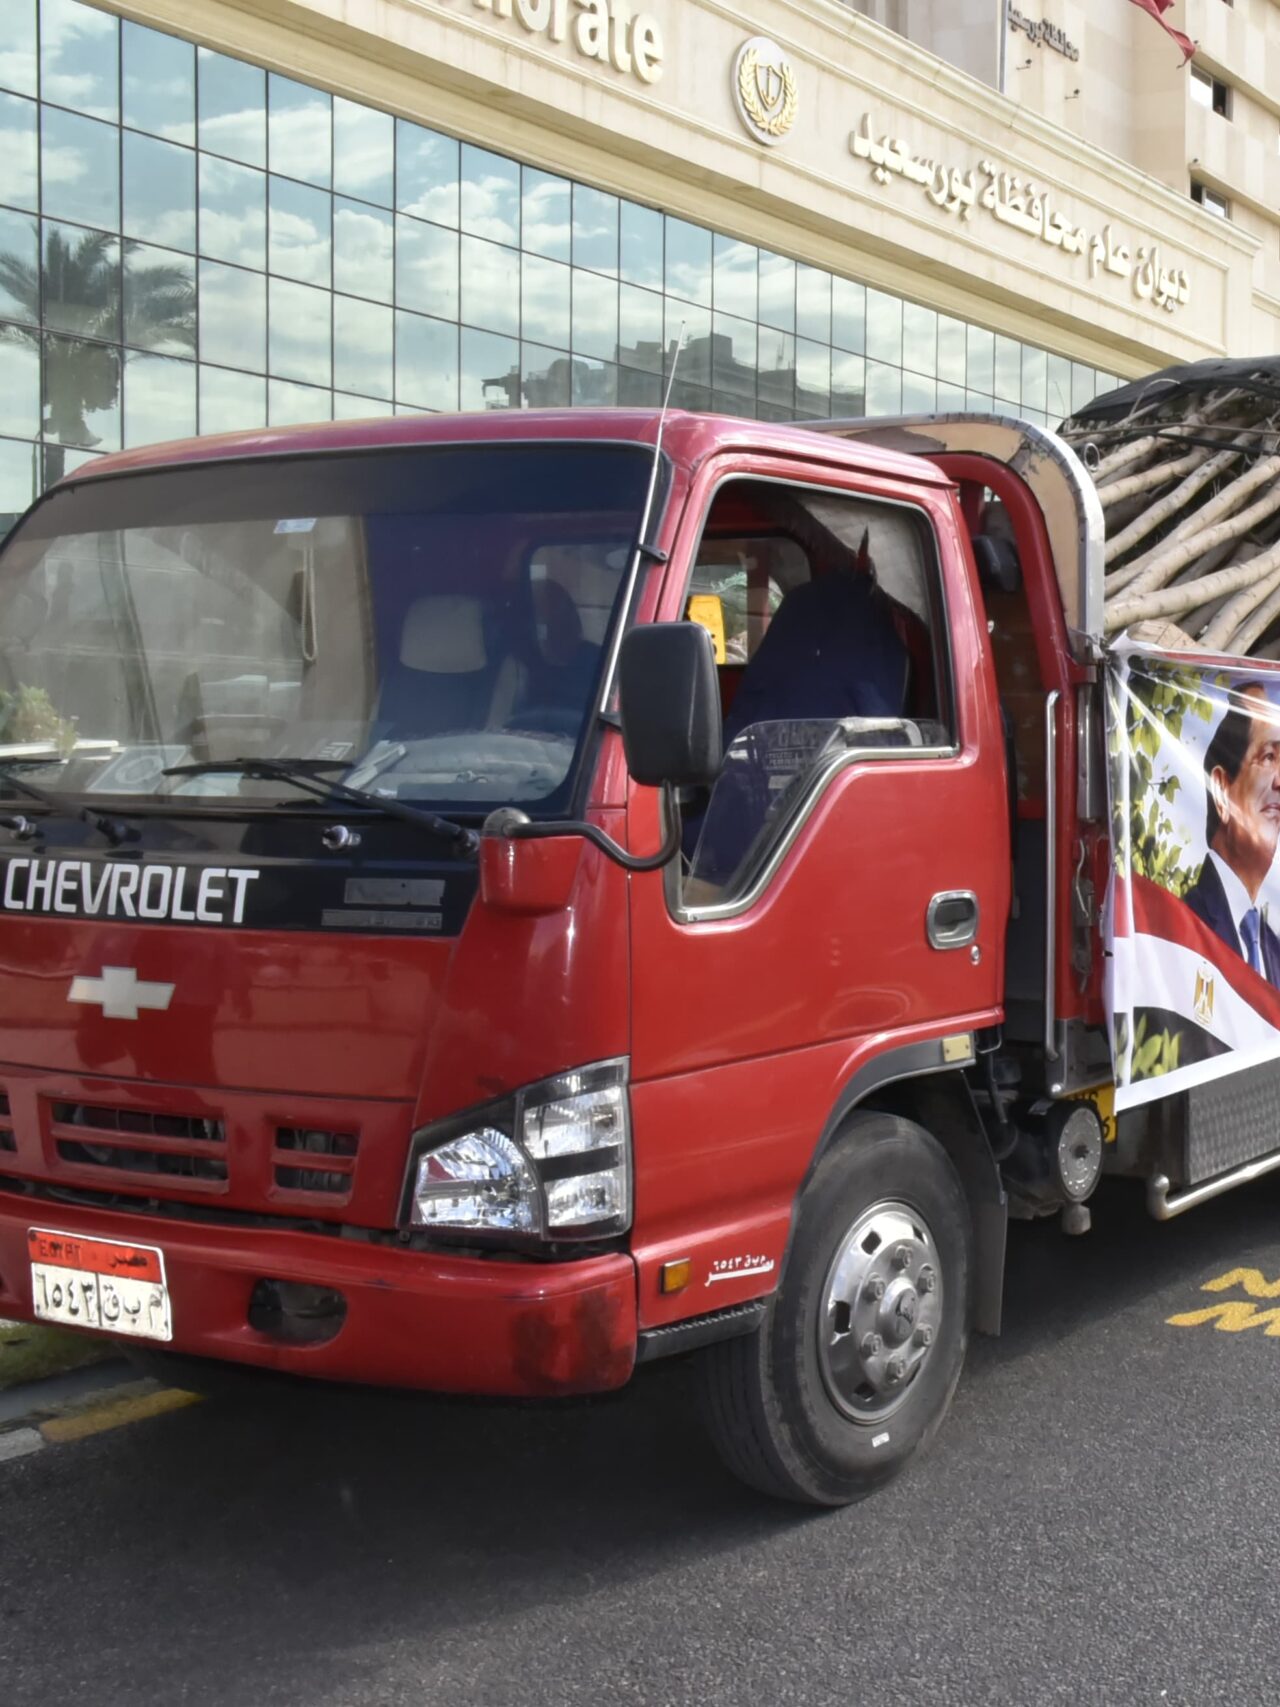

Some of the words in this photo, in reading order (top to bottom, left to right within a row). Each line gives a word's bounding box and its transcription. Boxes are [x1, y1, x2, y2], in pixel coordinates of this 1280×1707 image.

[472, 0, 663, 84] orate
[848, 112, 977, 222] بورسعيد
[978, 159, 1087, 255] محافظة
[1088, 224, 1132, 279] عام
[1133, 247, 1190, 313] ديوان
[4, 858, 260, 924] CHEVROLET
[109, 1254, 148, 1268] مصر
